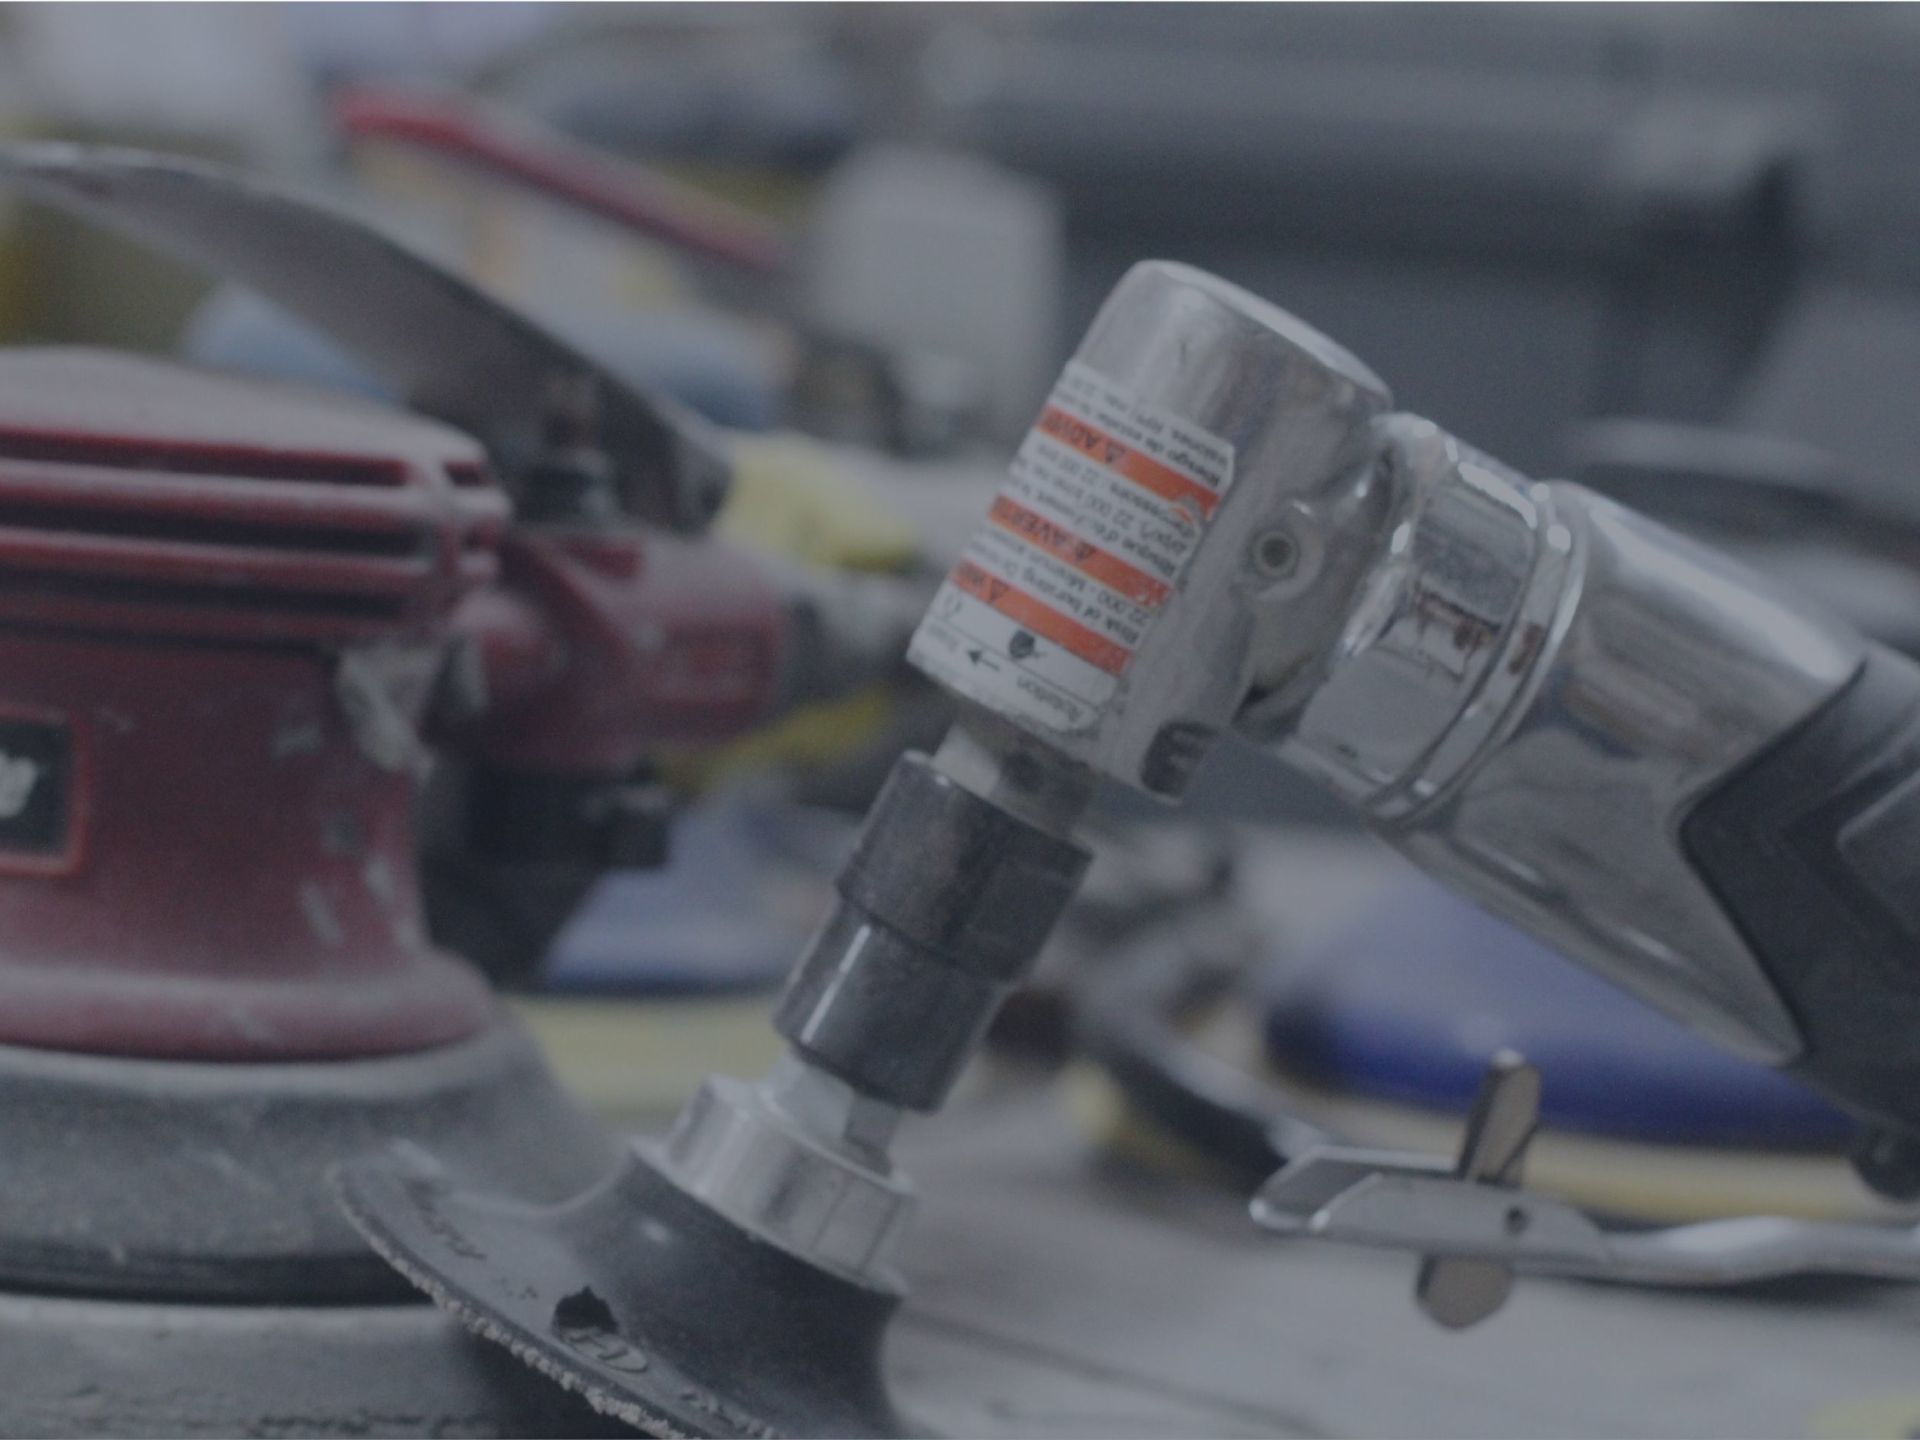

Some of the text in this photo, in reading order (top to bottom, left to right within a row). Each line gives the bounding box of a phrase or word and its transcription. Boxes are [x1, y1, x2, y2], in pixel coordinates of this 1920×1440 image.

[1142, 437, 1165, 457] de
[1164, 445, 1220, 488] Riesgo
[1119, 533, 1176, 577] Risque
[1081, 605, 1102, 623] of
[1102, 617, 1140, 644] Risk
[1014, 674, 1083, 724] Rotation
